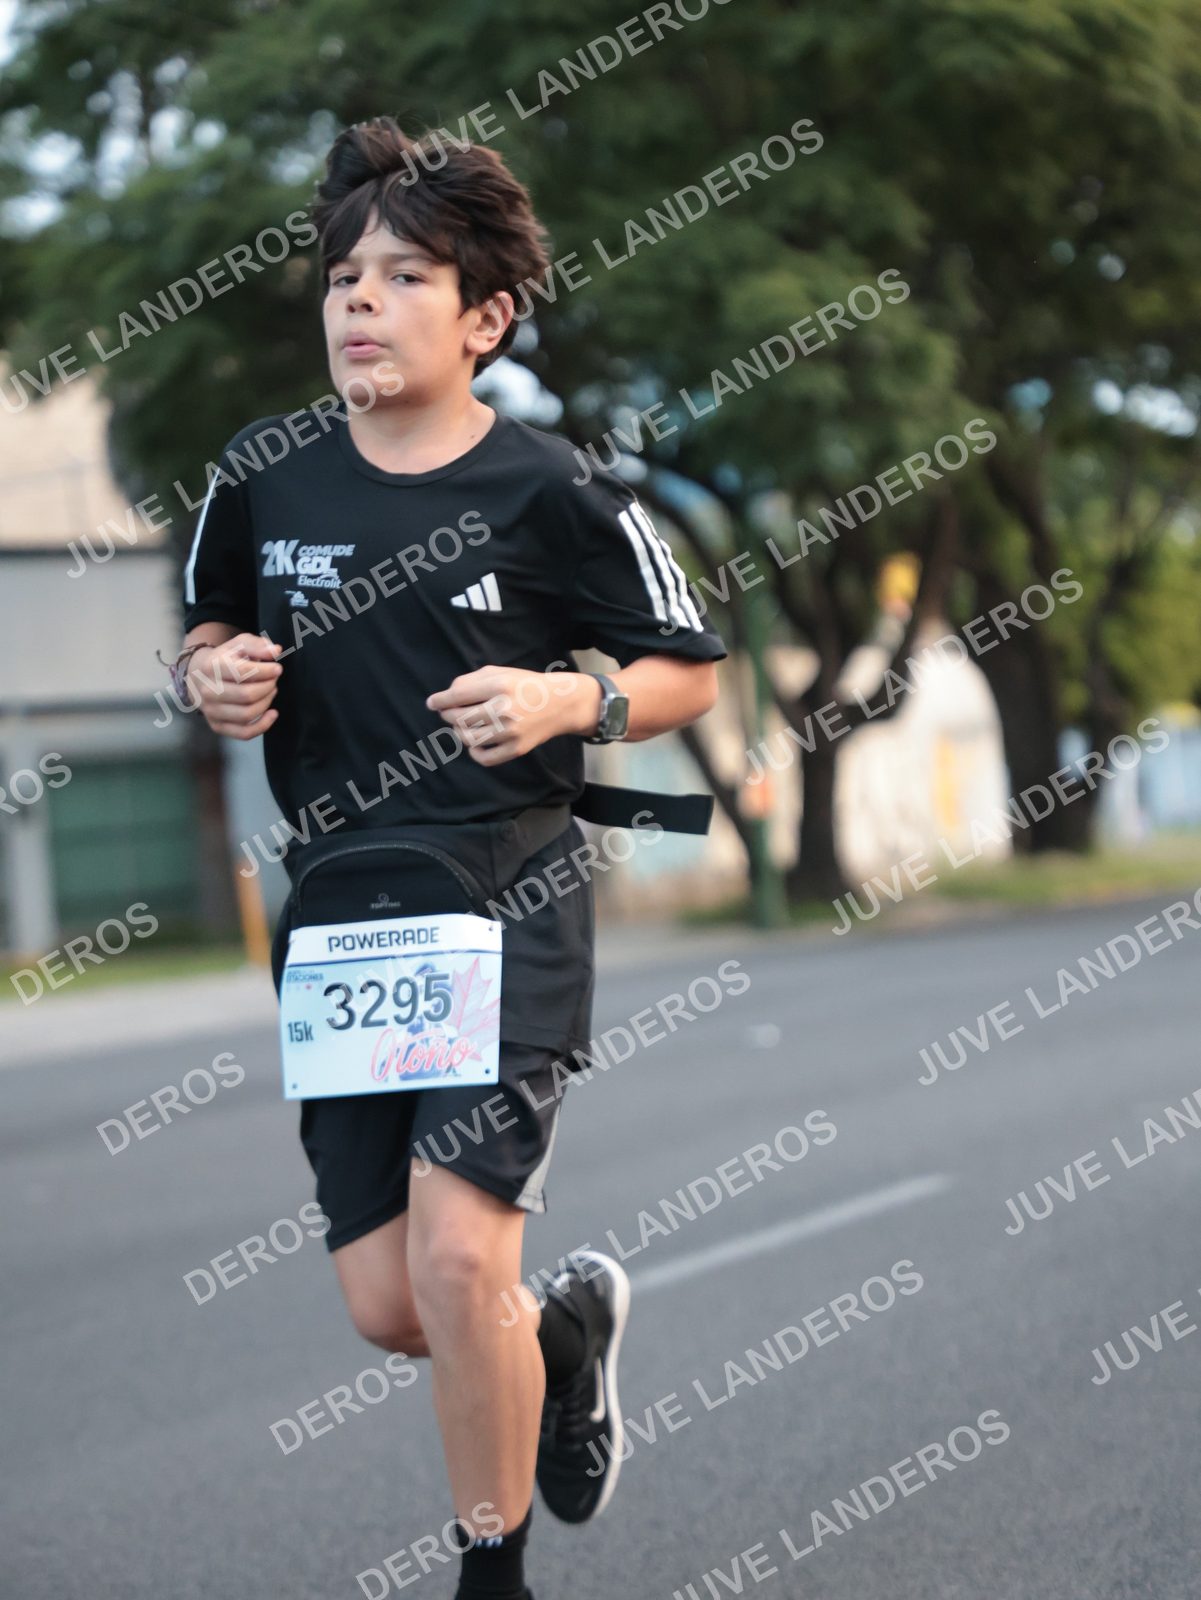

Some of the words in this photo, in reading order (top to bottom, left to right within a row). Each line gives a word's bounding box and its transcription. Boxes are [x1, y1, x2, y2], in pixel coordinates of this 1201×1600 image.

[297, 544, 356, 557] COMUDE
[296, 556, 338, 576] GDL
[328, 926, 440, 952] POWERADE
[323, 972, 453, 1031] 3295
[287, 1019, 314, 1042] 15k
